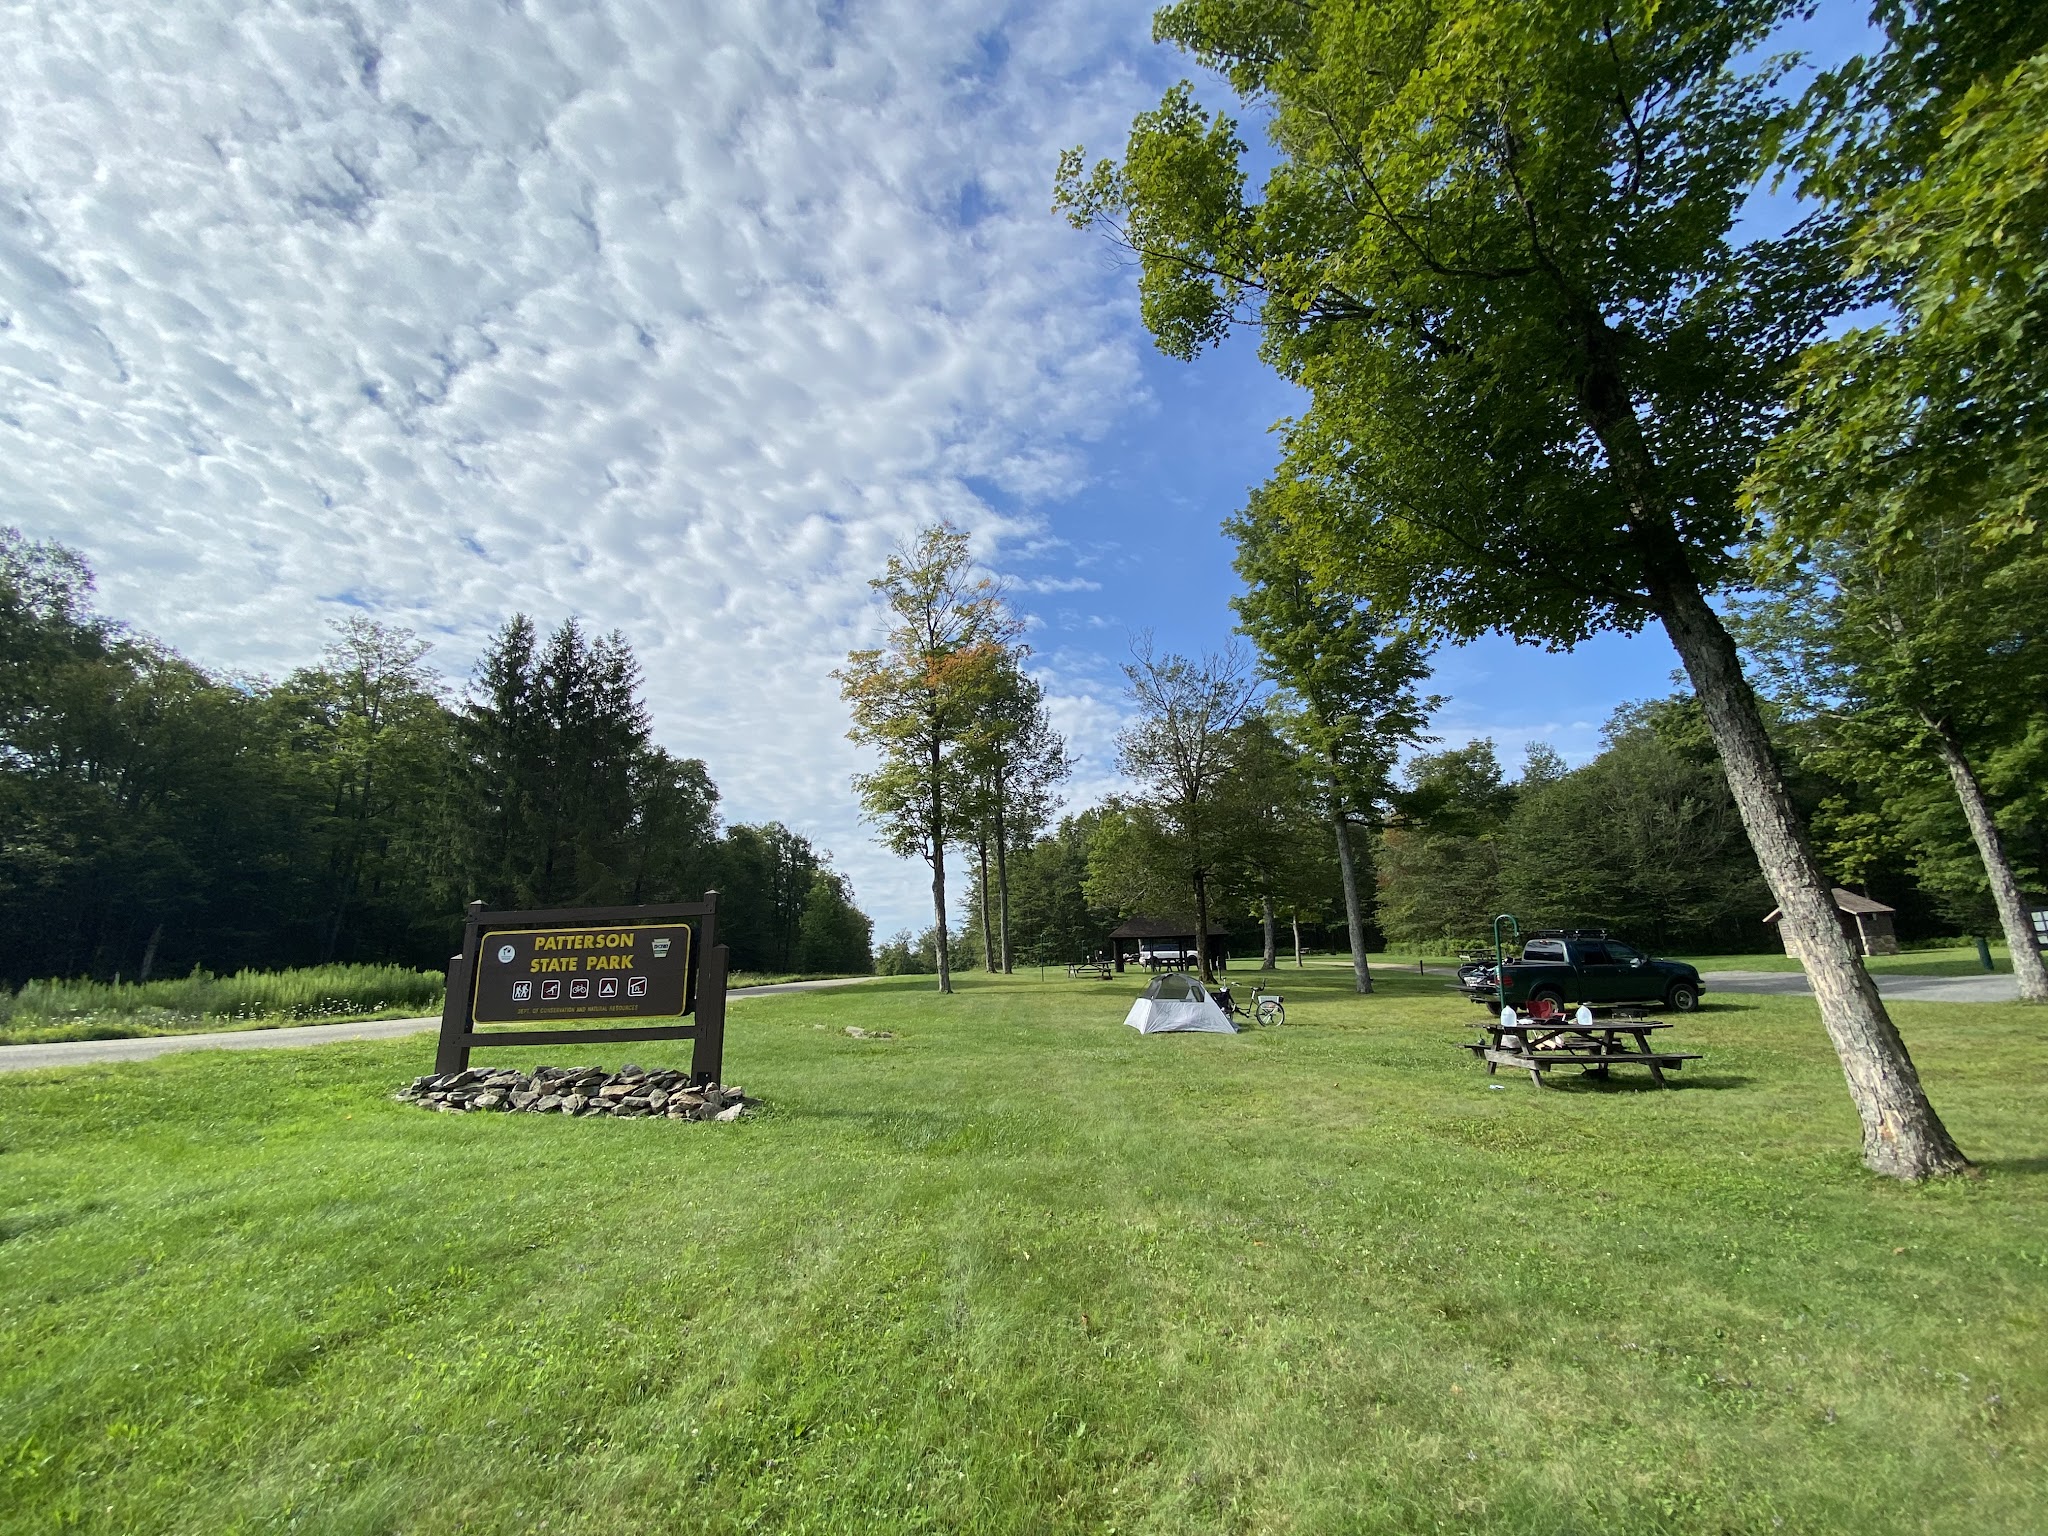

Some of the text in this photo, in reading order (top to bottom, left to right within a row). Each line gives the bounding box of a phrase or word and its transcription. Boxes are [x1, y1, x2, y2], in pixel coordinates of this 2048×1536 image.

[534, 933, 634, 951] PATTERSON
[530, 954, 634, 973] STATE PARK
[540, 1006, 575, 1014] CONSERVATION
